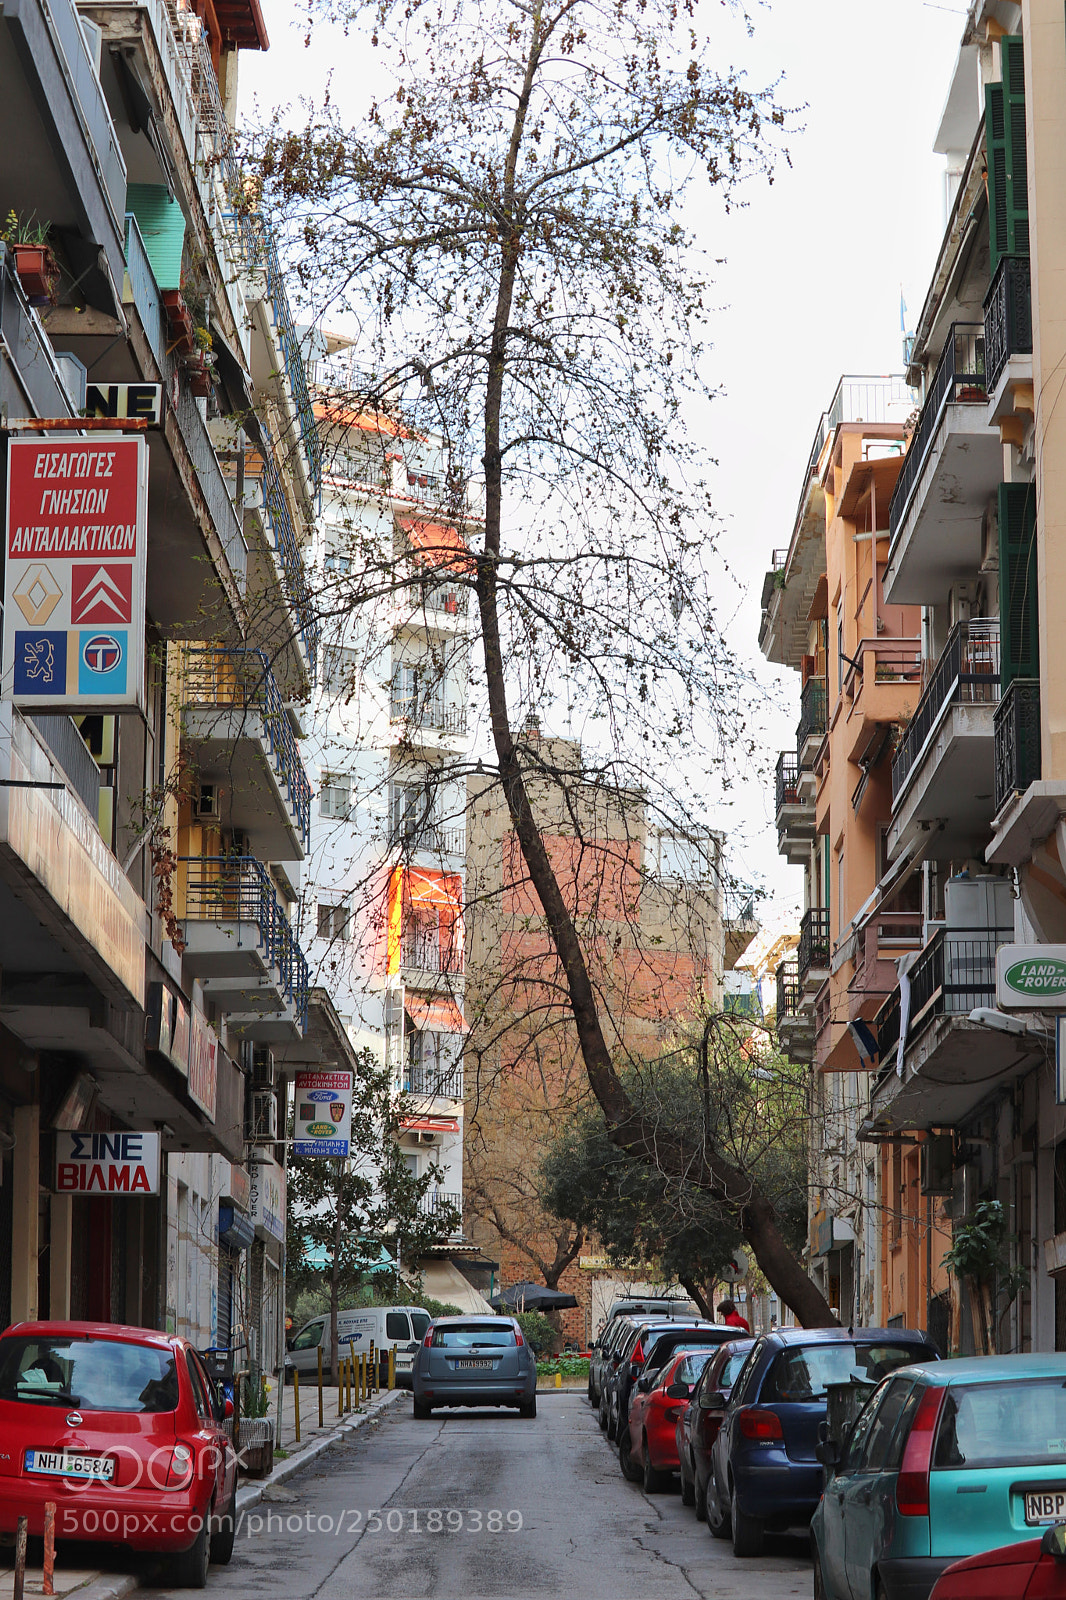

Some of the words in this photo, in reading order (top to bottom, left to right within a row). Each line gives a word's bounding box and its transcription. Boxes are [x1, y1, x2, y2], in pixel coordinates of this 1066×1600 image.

[34, 451, 116, 478] ΕΙΣΑΓΩΓΕΣ
[40, 488, 109, 514] ΓΝΗΣΙΩΝ
[11, 524, 136, 552] ΑΝΤΑΛΛΑΚΤΙΚΩΝ
[1021, 965, 1056, 976] LAND
[1024, 976, 1066, 988] ROVER
[313, 1091, 333, 1101] Ford
[70, 1133, 143, 1160] ΣΙΝΕ
[57, 1163, 151, 1191] ΒΙΛΜΑ
[251, 1184, 259, 1217] ROVER
